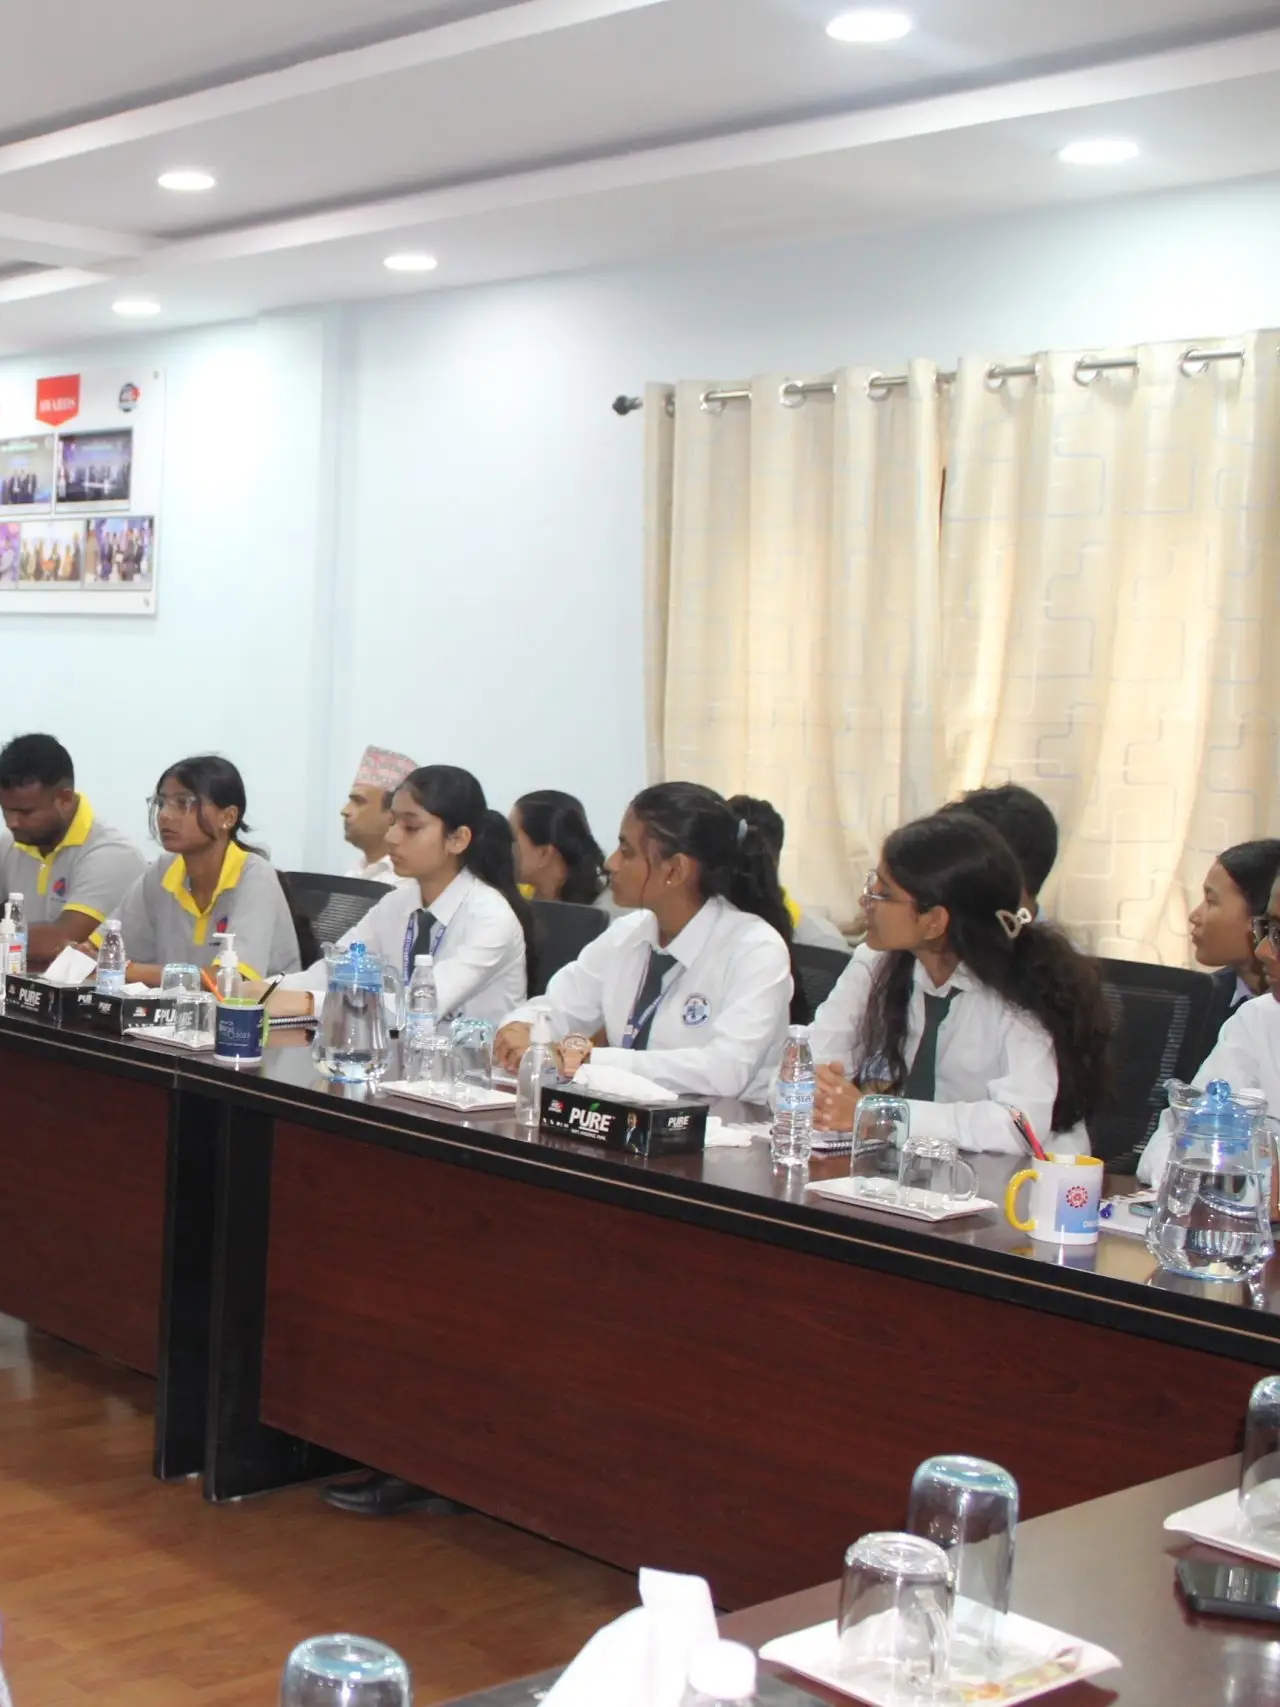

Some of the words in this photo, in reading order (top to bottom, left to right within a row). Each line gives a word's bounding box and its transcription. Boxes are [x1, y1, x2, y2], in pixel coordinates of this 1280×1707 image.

[19, 987, 43, 1006] PURE
[569, 1106, 611, 1133] PURE
[667, 1115, 691, 1128] PURE
